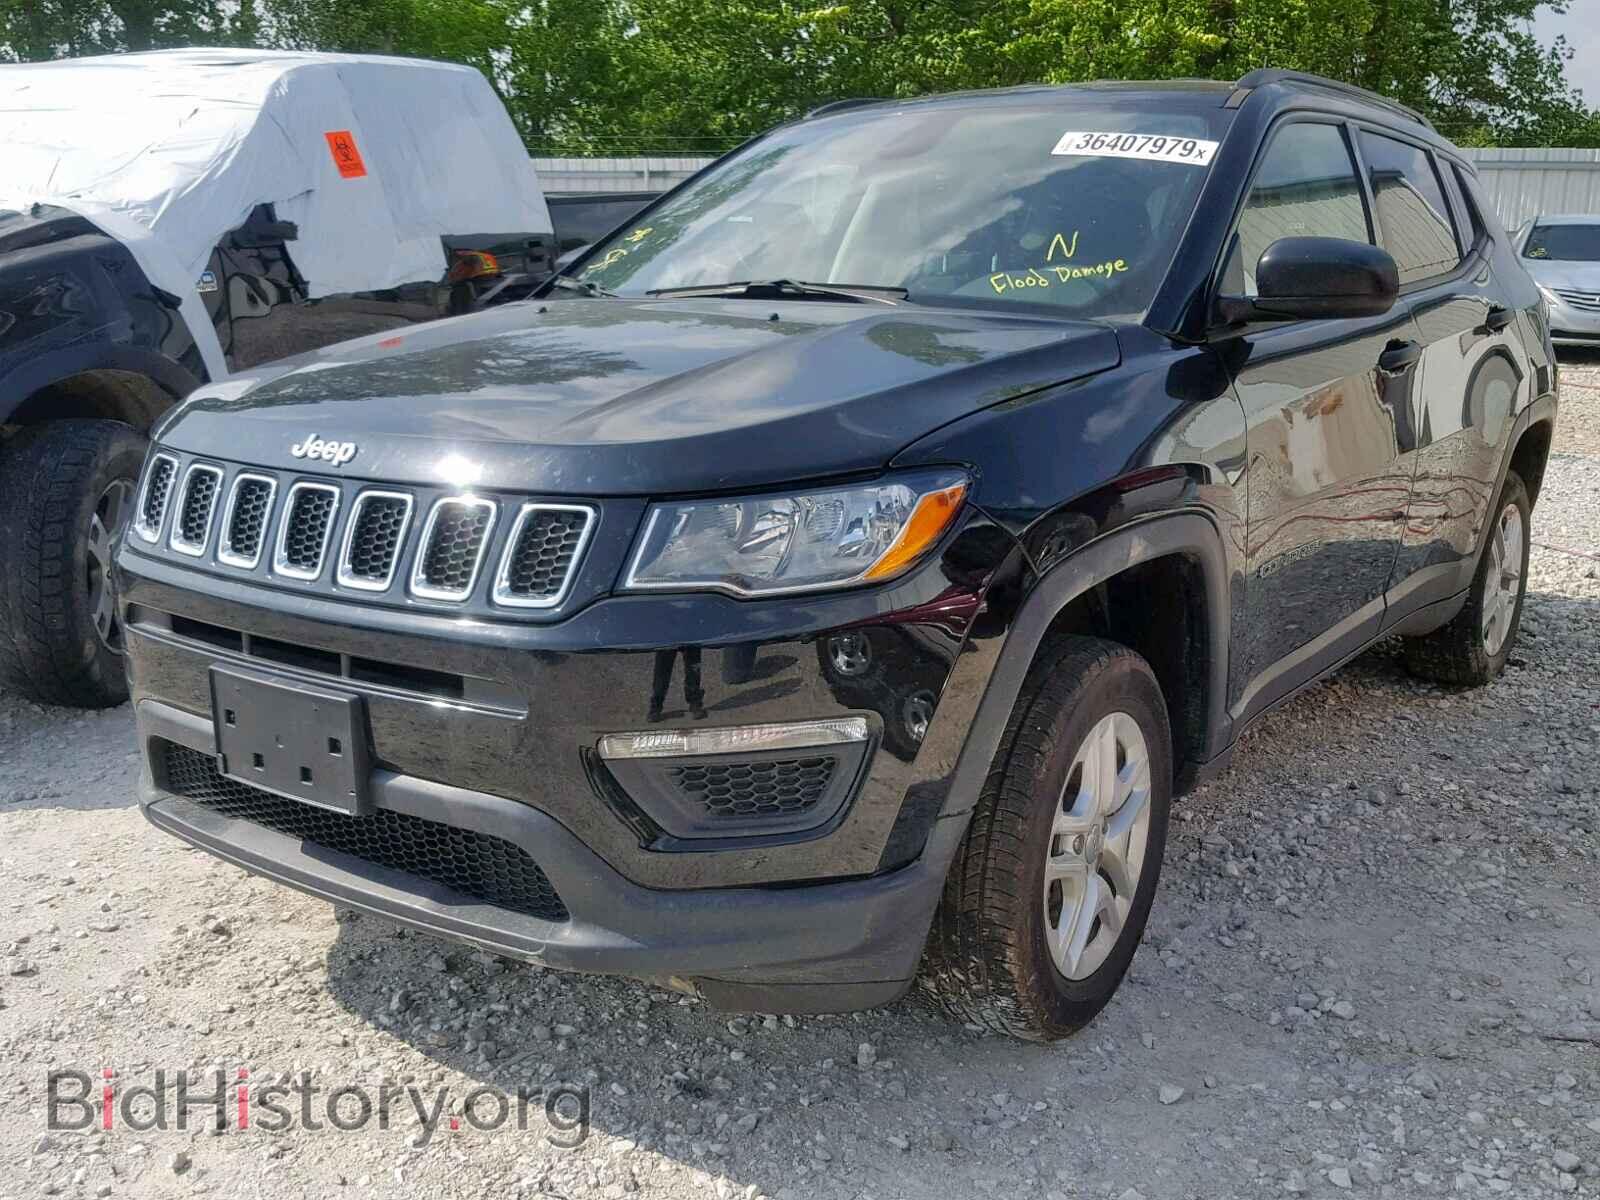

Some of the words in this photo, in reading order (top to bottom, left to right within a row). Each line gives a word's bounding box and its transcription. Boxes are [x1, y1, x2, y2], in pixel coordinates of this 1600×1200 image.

[1046, 230, 1079, 261] N
[1055, 258, 1129, 283] Damage
[291, 432, 358, 468] Jeep
